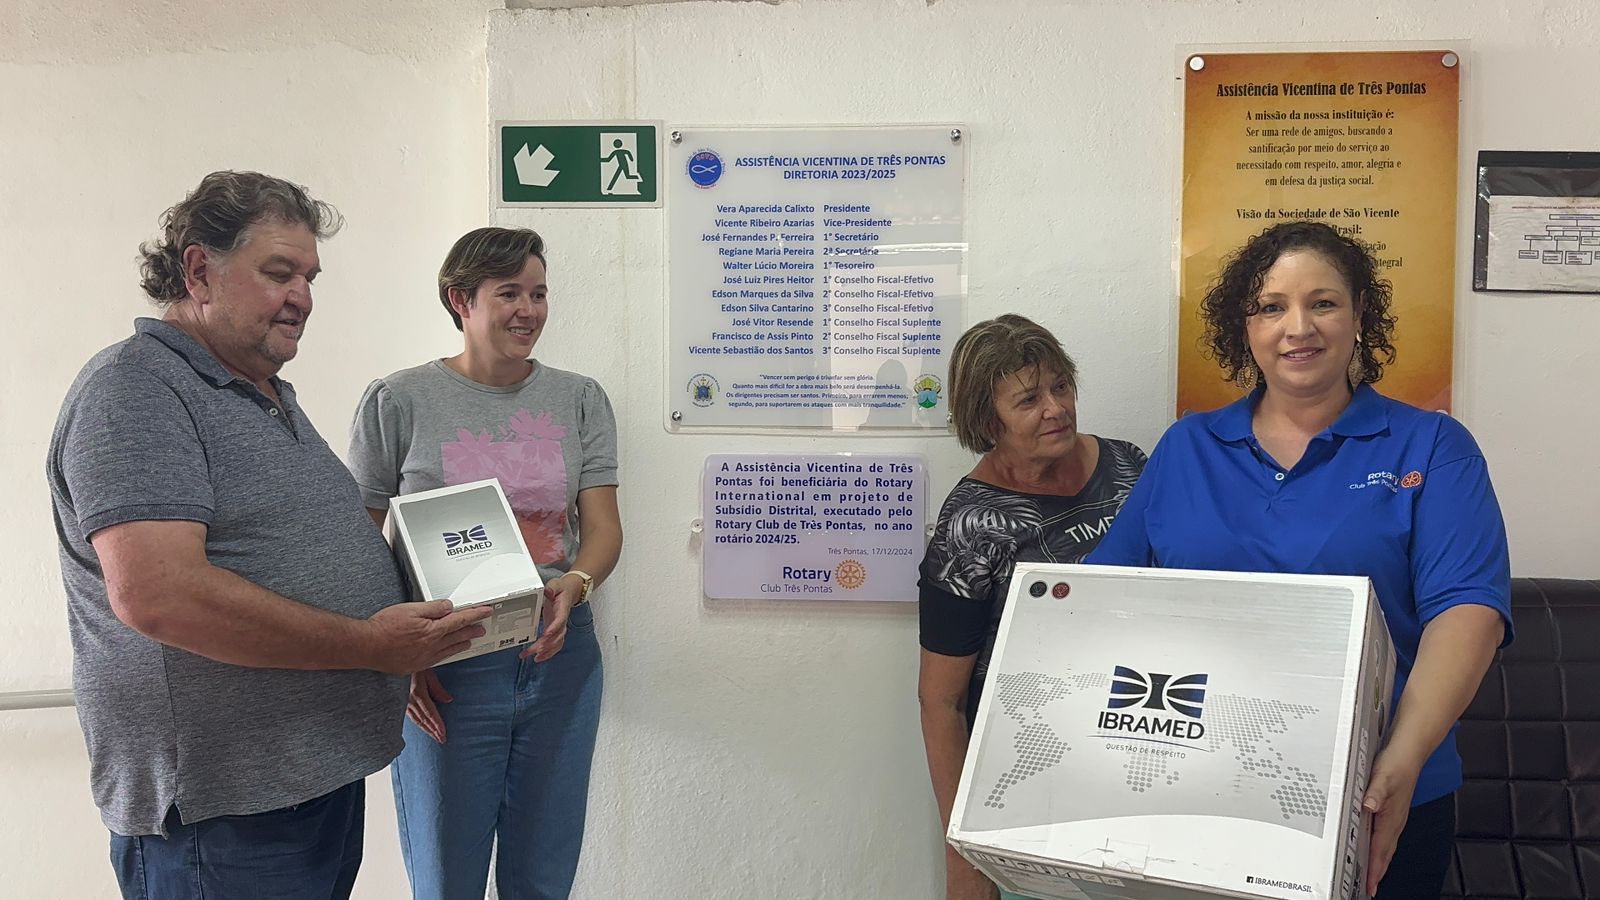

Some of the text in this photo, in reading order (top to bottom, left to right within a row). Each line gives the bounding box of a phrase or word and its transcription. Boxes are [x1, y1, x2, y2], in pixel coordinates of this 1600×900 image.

[1216, 81, 1426, 97] Assistência Vicentina de Três Pontas
[1255, 110, 1287, 120] missão
[1289, 110, 1301, 120] da
[1332, 109, 1383, 120] instituição
[1246, 127, 1259, 137] Ser
[1262, 129, 1279, 137] uma
[1281, 126, 1299, 136] rede
[1348, 125, 1386, 135] buscando
[1249, 142, 1378, 155] santificação por meio serviço
[735, 154, 946, 167] ASSISTÊNCIA VICENTINA DE TRÊS PONTAS
[1236, 160, 1282, 170] necessitado
[1366, 158, 1394, 171] alegria
[784, 169, 896, 179] DIRETORIA 2023/2025
[1280, 175, 1374, 188] defesa da justiça social.
[717, 204, 870, 213] Vera Aparecida Calixto Presidente
[1237, 208, 1399, 219] Visão da Sociedade de São Vicente
[715, 218, 892, 227] Vicente Ribeiro Azarias Vice-Presidente
[702, 233, 879, 241] José Fernandes P. Ferreira Secretário
[719, 247, 753, 257] Regiane
[755, 247, 781, 255] Maria
[783, 247, 814, 255] Pereira
[723, 261, 875, 270] Walter Lúcio Moreira Tesoreiro
[723, 275, 934, 284] José Luiz Pires Heitor Conselho Fiscal-Efetivo
[712, 290, 934, 299] Edson Marques da Silva Conselho Fiscal-Efetivo
[721, 304, 934, 312] Edson Silva Cantarino Conselho Fiscal-Efetivo
[732, 318, 941, 327] José Vitor Resende Conselho Fiscal Suplente
[712, 332, 941, 342] Francisco de Assis Pinto Conselho Fiscal Suplente
[688, 346, 941, 356] Vicente Sebastião dos Santos Conselho Fiscal Suplente
[721, 462, 913, 473] A Assistência Vicentina de Três
[716, 476, 913, 490] Pontas foi beneficiária do Rotary
[715, 491, 804, 501] International
[840, 492, 889, 504] projeto
[898, 491, 913, 502] de
[715, 505, 912, 518] Subsídio Distrital, executado pelo
[715, 520, 752, 531] Rotary
[756, 519, 779, 529] Club
[783, 519, 797, 529] de
[800, 520, 822, 530] Três
[826, 520, 866, 531] Pontas,
[715, 534, 800, 544] rotário 2024/25.
[446, 541, 492, 556] IBRAMED
[828, 547, 842, 555] Três
[843, 547, 869, 555] Pontas,
[783, 566, 831, 582] Rotary
[760, 584, 833, 593] Club Três Pontas
[1098, 711, 1205, 740] IBRAMED
[1105, 743, 1138, 753] QUESTÃO
[1151, 749, 1186, 759] RESPEITO
[1255, 877, 1312, 893] IBRAMEDBRASIL
